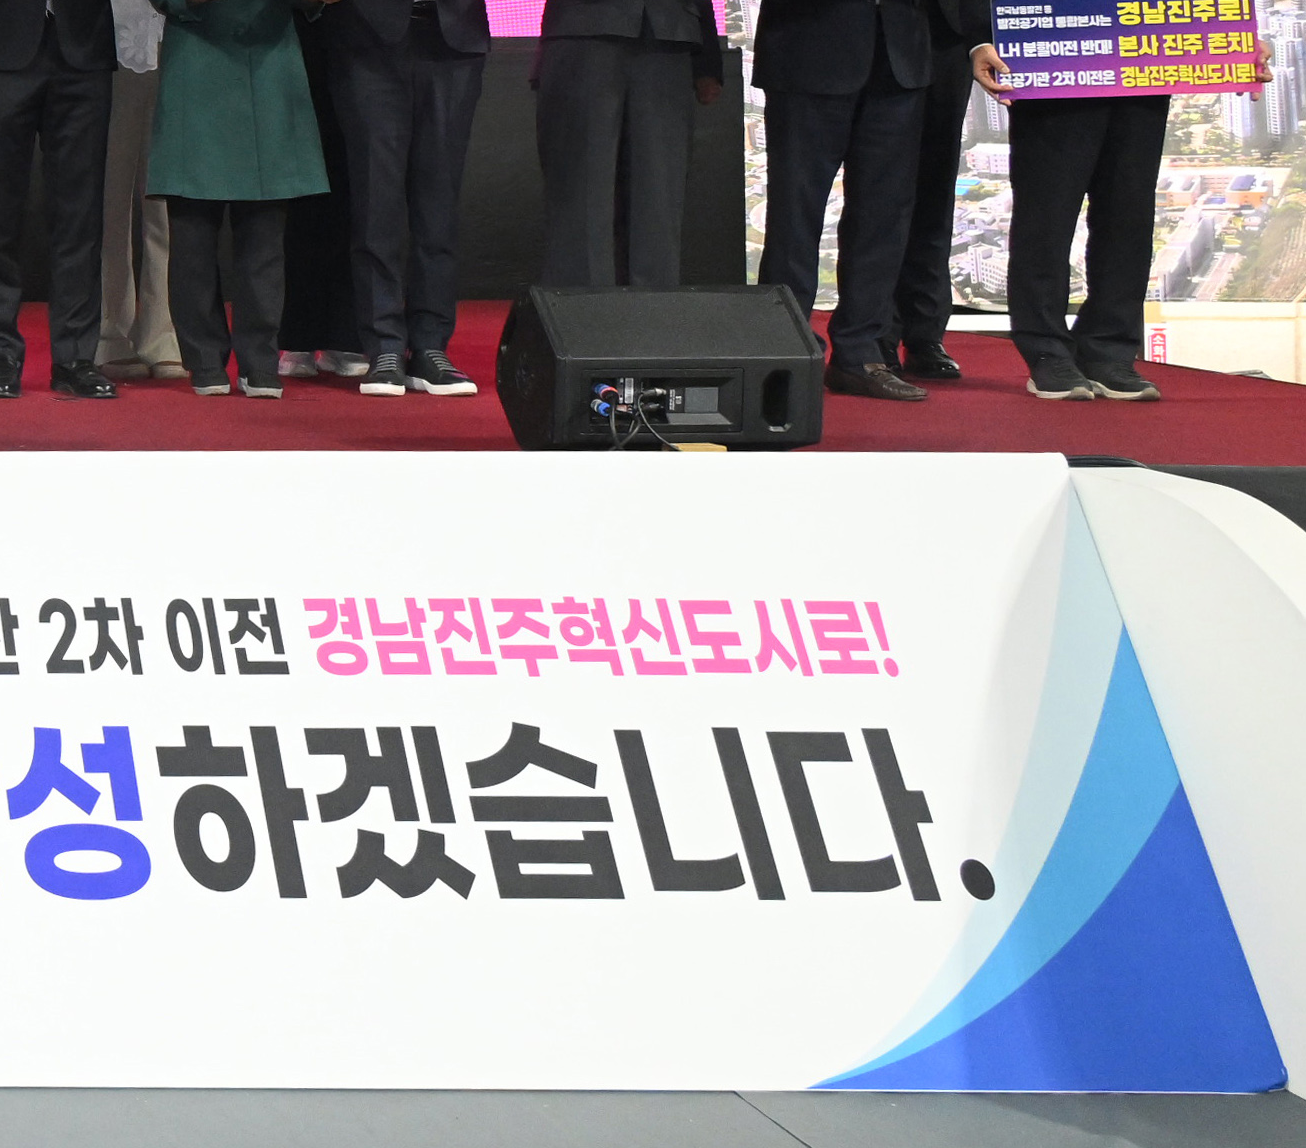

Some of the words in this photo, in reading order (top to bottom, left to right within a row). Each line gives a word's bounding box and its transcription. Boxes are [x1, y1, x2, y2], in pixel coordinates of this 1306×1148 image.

[1117, 33, 1160, 58] 본사
[1161, 32, 1203, 56] 진주
[1207, 30, 1255, 55] 존치!
[39, 597, 145, 676] 2차
[165, 597, 291, 676] 이전
[302, 596, 900, 678] 경남진주혁신도시로!
